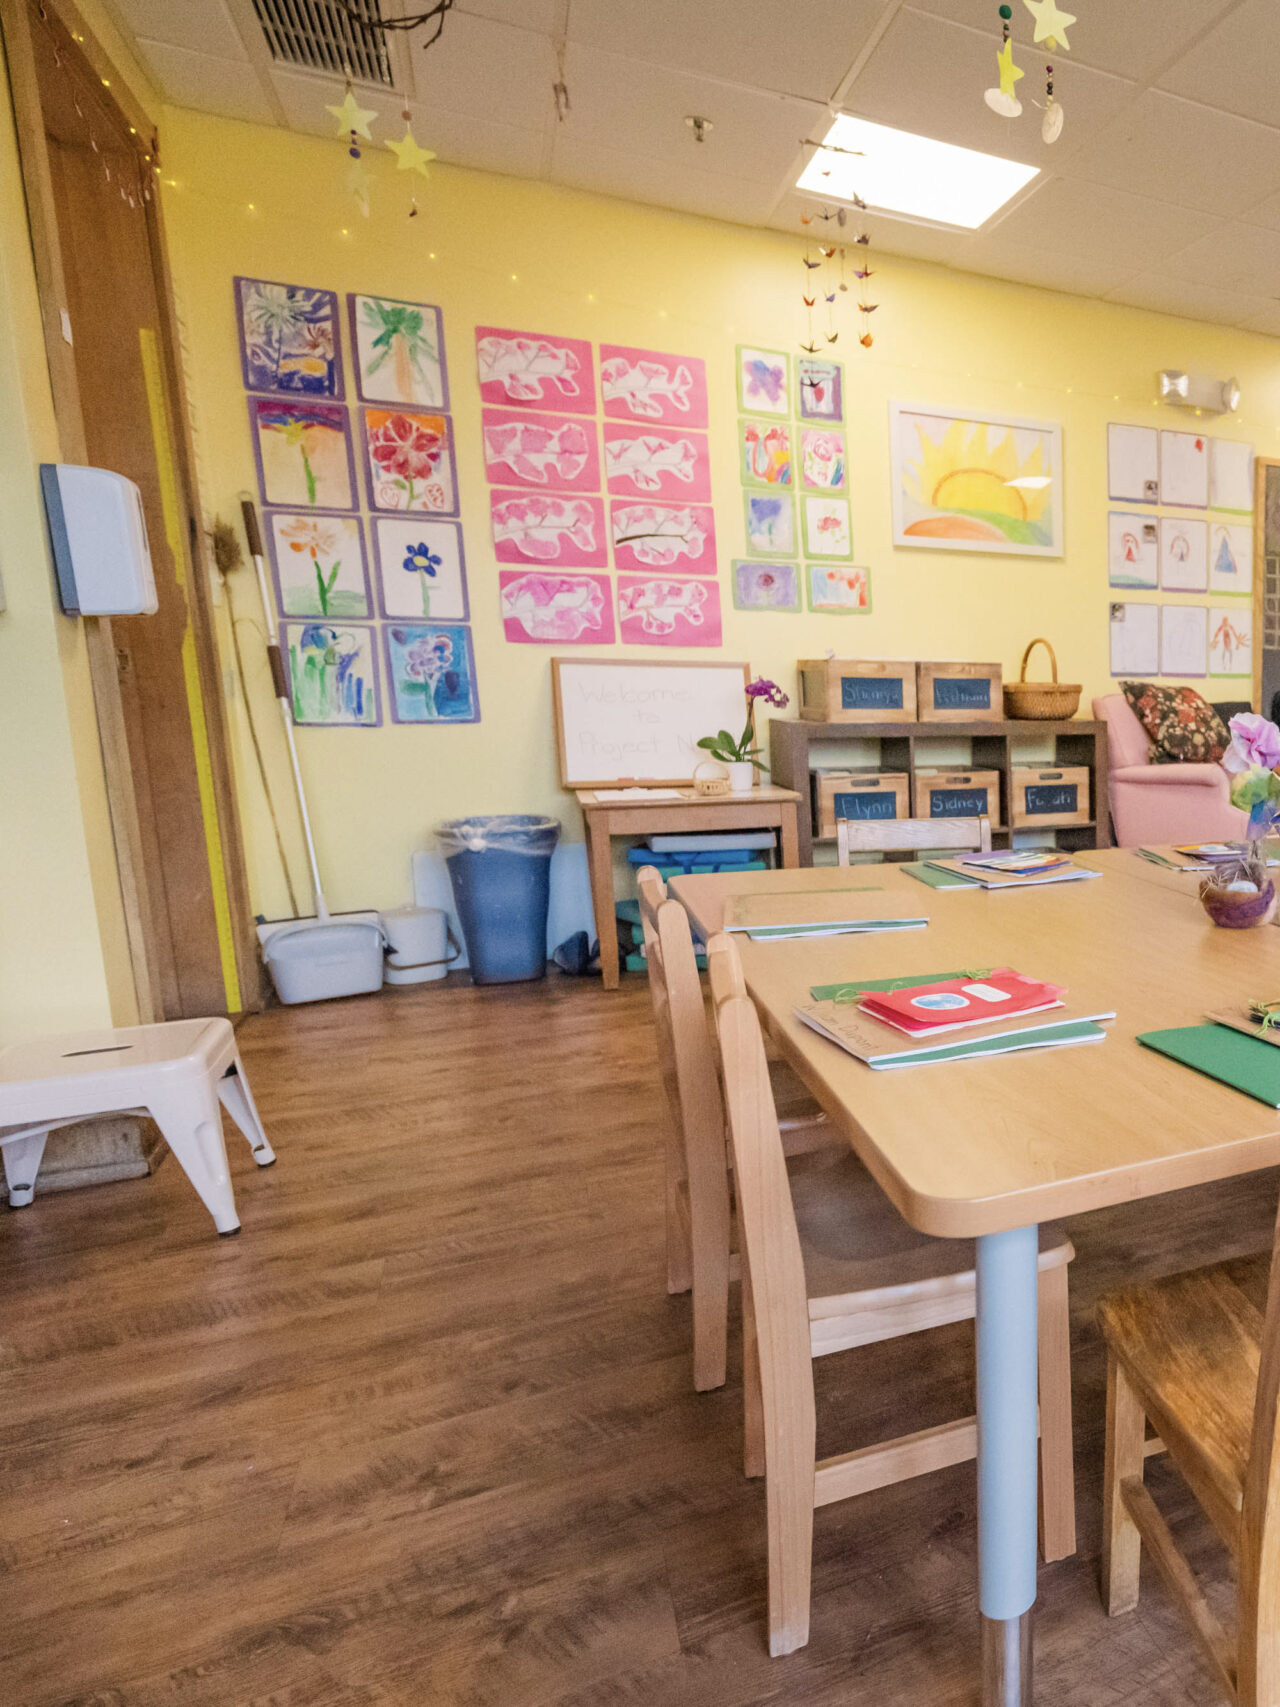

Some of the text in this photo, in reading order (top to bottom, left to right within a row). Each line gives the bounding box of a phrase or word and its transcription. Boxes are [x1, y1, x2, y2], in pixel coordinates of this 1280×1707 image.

[577, 681, 693, 705] Welcome
[632, 708, 663, 724] to
[578, 730, 664, 762] Project
[841, 797, 893, 819] Flynn
[932, 795, 984, 812] Sidney
